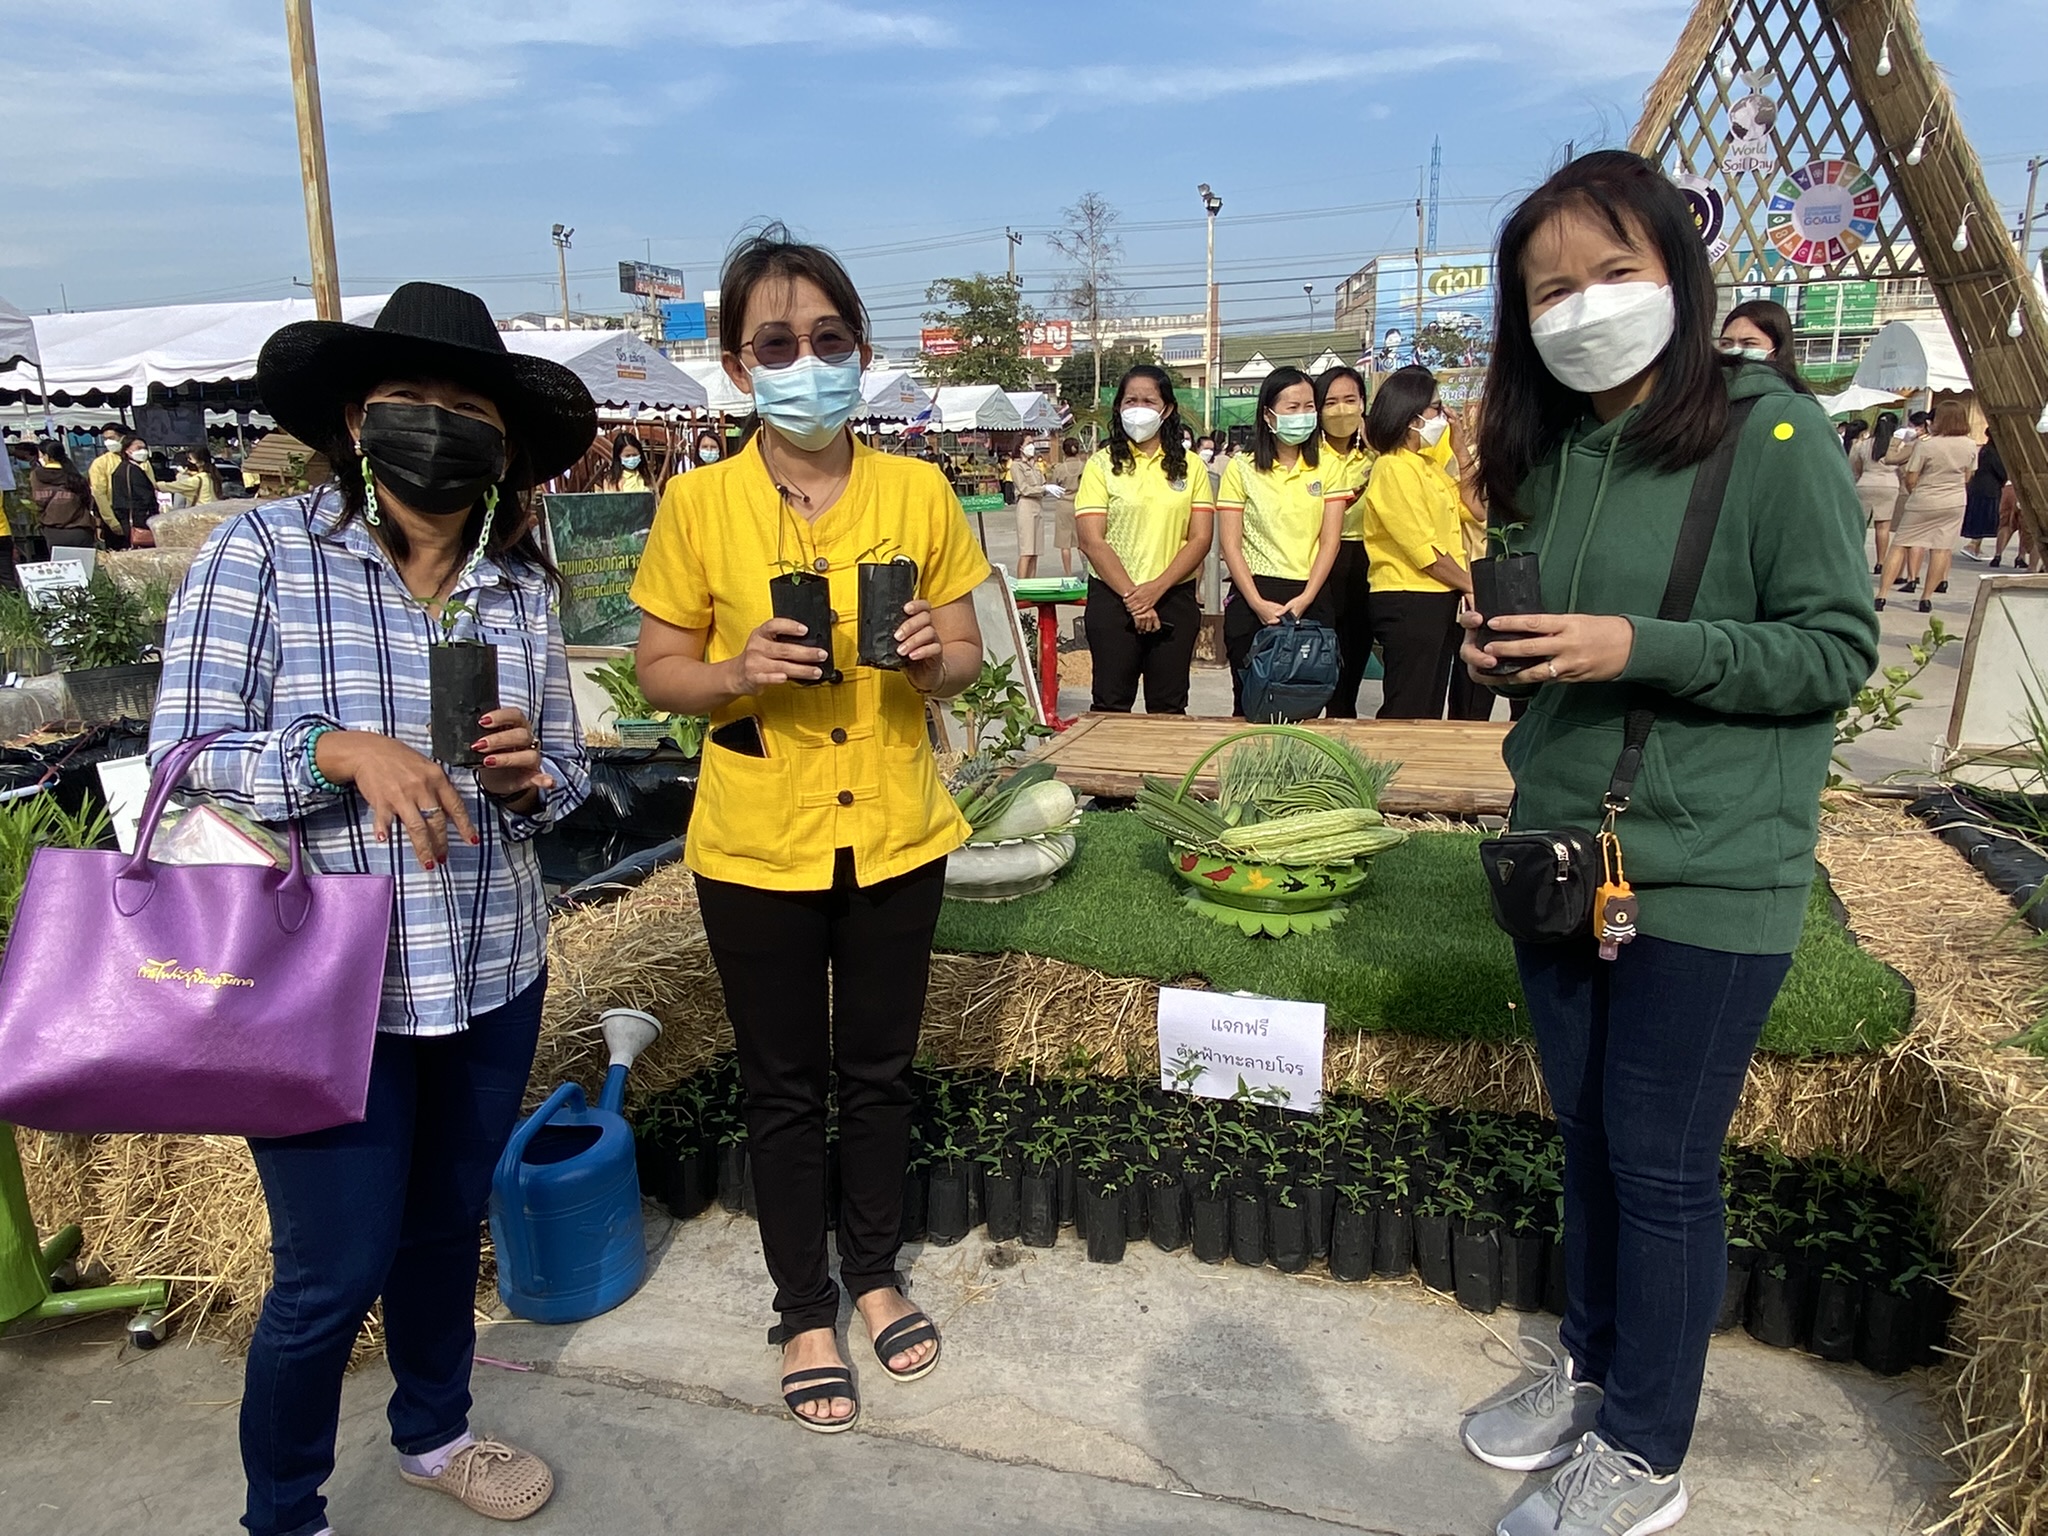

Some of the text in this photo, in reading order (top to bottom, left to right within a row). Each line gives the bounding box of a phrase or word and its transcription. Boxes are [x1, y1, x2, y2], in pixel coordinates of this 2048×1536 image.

[1732, 142, 1767, 156] World
[1723, 157, 1774, 173] Soil Day
[1803, 214, 1841, 226] GOALS
[1210, 1017, 1270, 1037] แจกฟรี
